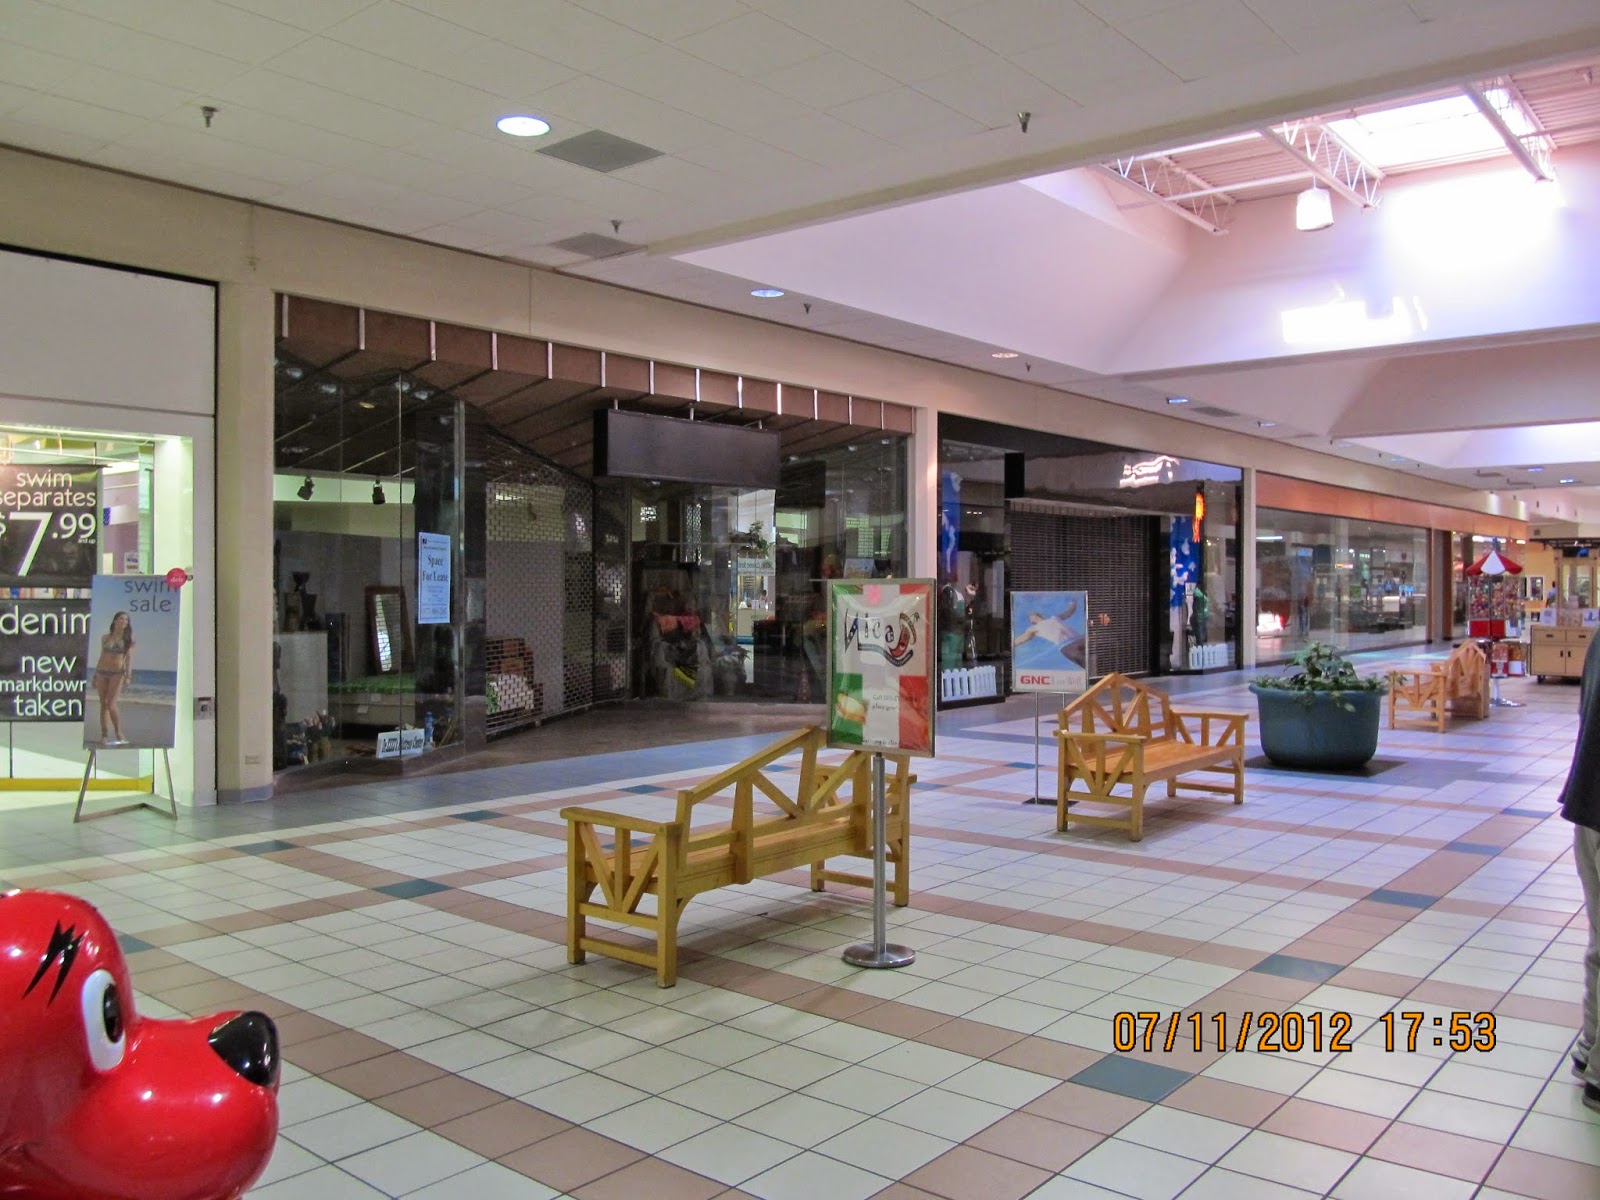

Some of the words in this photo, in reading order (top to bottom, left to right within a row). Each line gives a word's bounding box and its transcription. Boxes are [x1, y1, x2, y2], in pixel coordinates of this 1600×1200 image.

[17, 469, 73, 487] swim
[427, 555, 444, 568] Space
[422, 570, 433, 582] For
[434, 572, 449, 583] Lease
[129, 594, 171, 613] sale
[21, 655, 77, 673] new
[1020, 675, 1051, 685] GNC
[13, 692, 83, 716] taken
